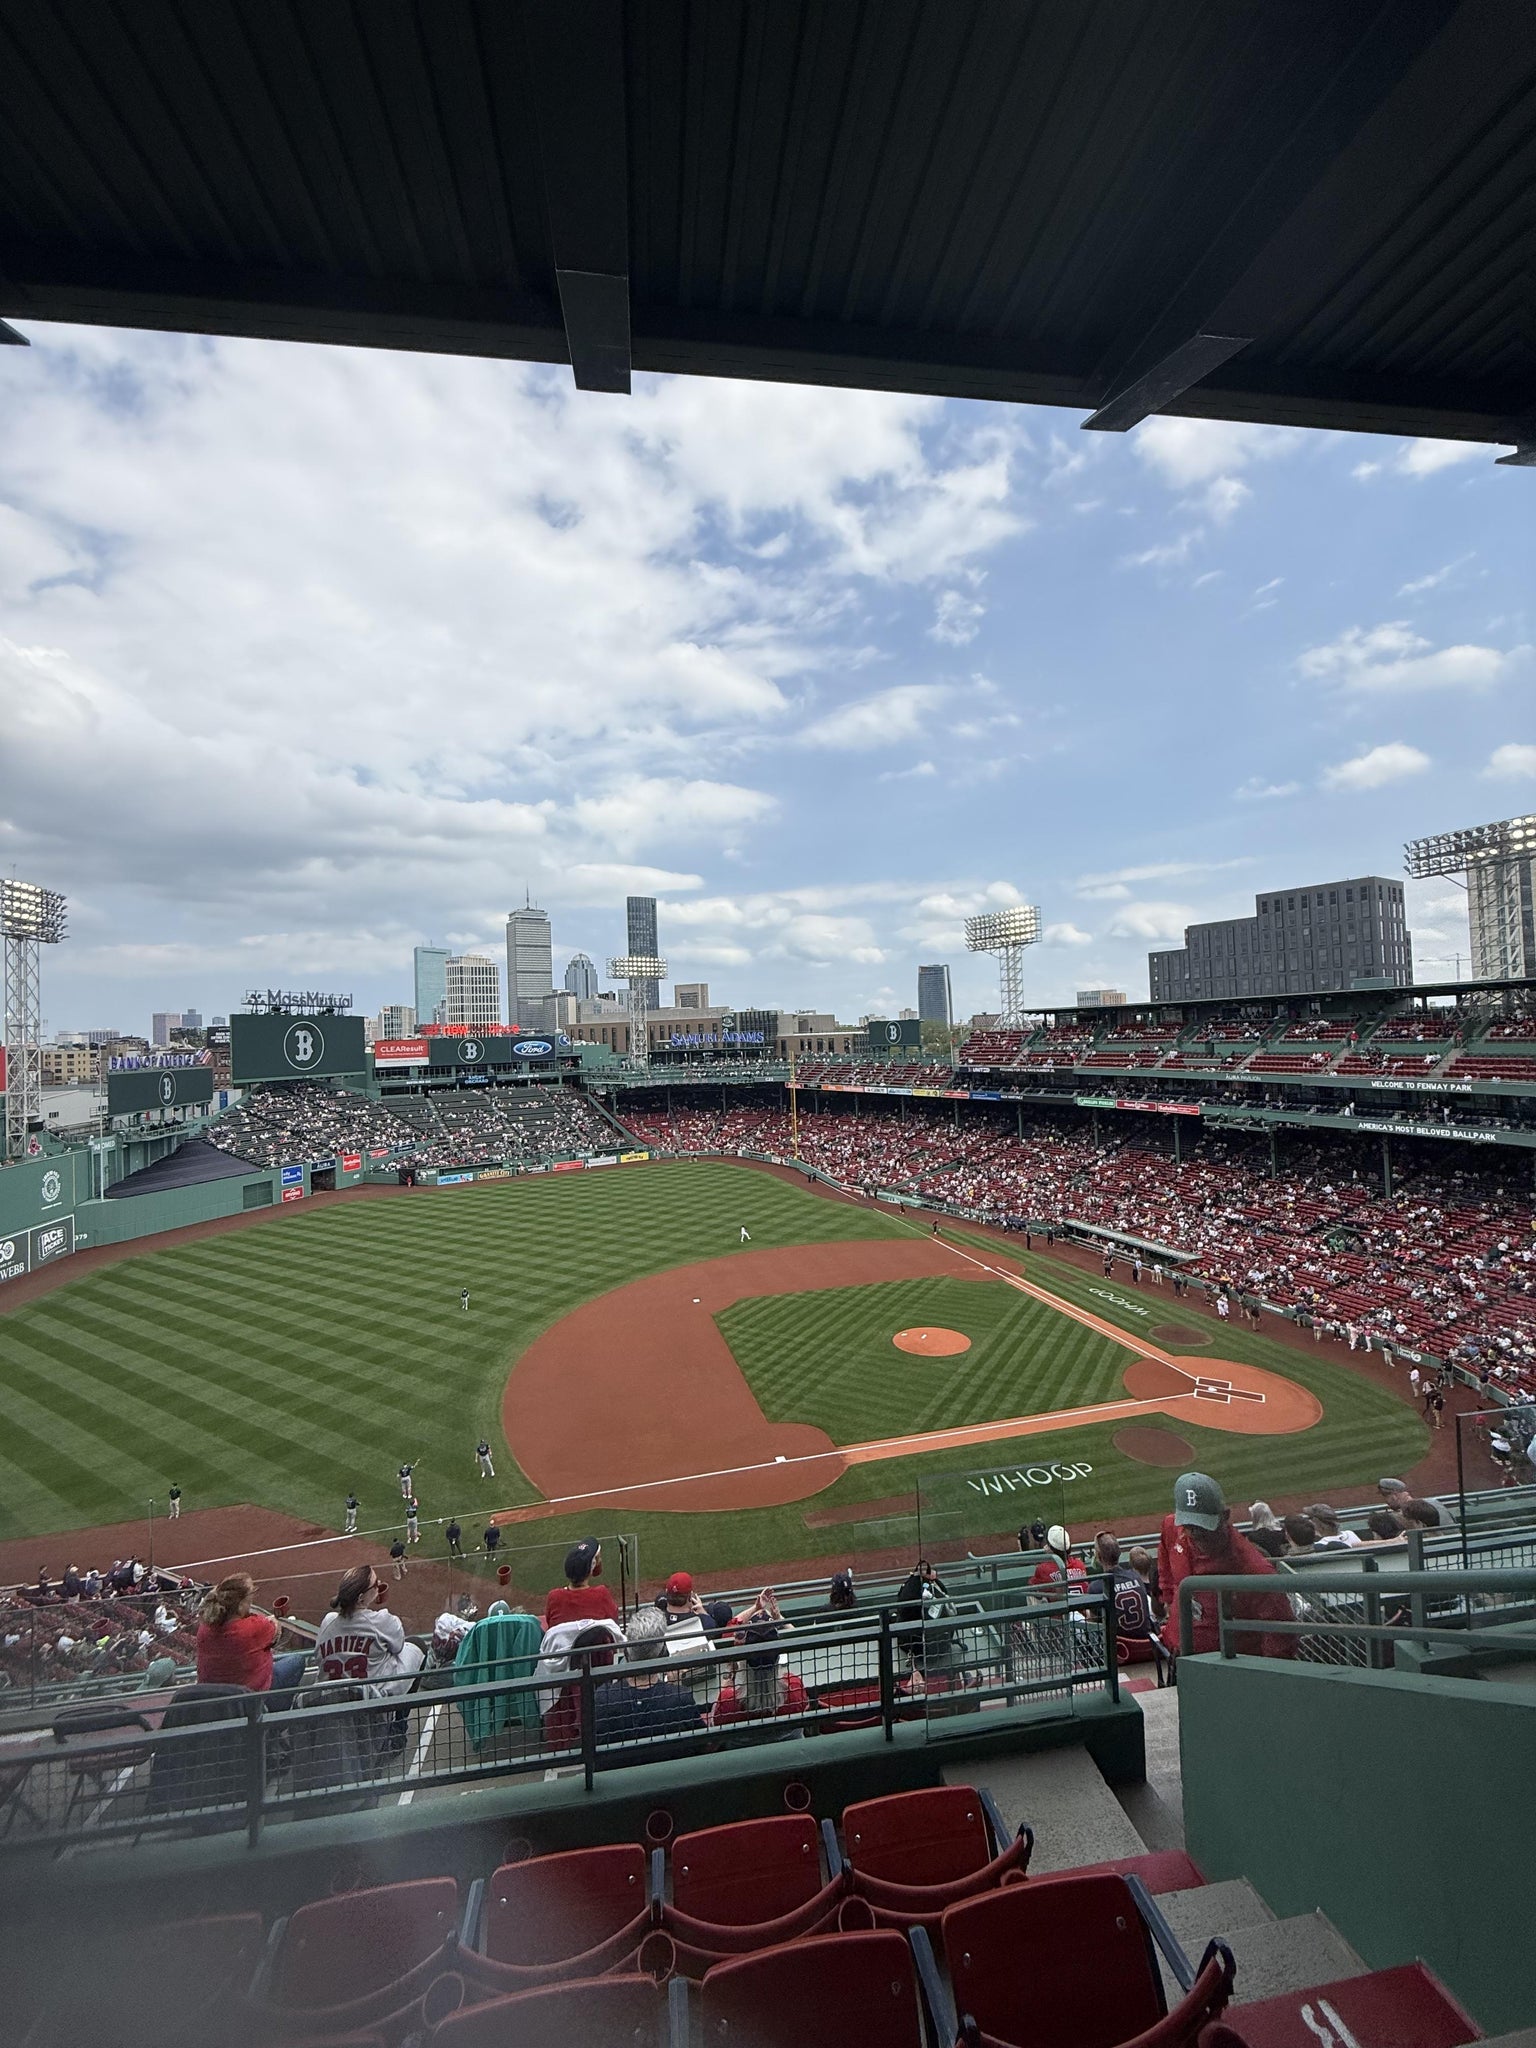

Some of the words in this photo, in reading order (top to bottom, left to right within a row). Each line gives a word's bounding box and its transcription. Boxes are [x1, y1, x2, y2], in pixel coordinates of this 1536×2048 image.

[268, 989, 352, 1007] MassMutual
[671, 1033, 718, 1046] SAMUEL
[722, 1031, 764, 1043] ADAMS
[889, 1025, 897, 1040] B
[295, 1030, 314, 1061] B
[465, 1043, 478, 1059] B
[521, 1043, 544, 1053] Ford
[110, 1056, 140, 1069] BANK
[142, 1055, 157, 1068] OF
[163, 1077, 172, 1100] B
[1417, 1082, 1448, 1091] FENWAY
[1450, 1084, 1472, 1092] PARK
[1358, 1122, 1393, 1132] AMERICA'S
[1416, 1127, 1451, 1137] BELOVED
[1452, 1130, 1496, 1141] BALLPARK
[43, 1229, 64, 1244] ACE
[43, 1237, 64, 1252] TICKET
[0, 1262, 25, 1280] WEBB
[1088, 1288, 1150, 1316] WHOOP
[967, 1462, 1093, 1496] WHOOP
[1186, 1489, 1197, 1506] B
[320, 1635, 374, 1659] VARITEK
